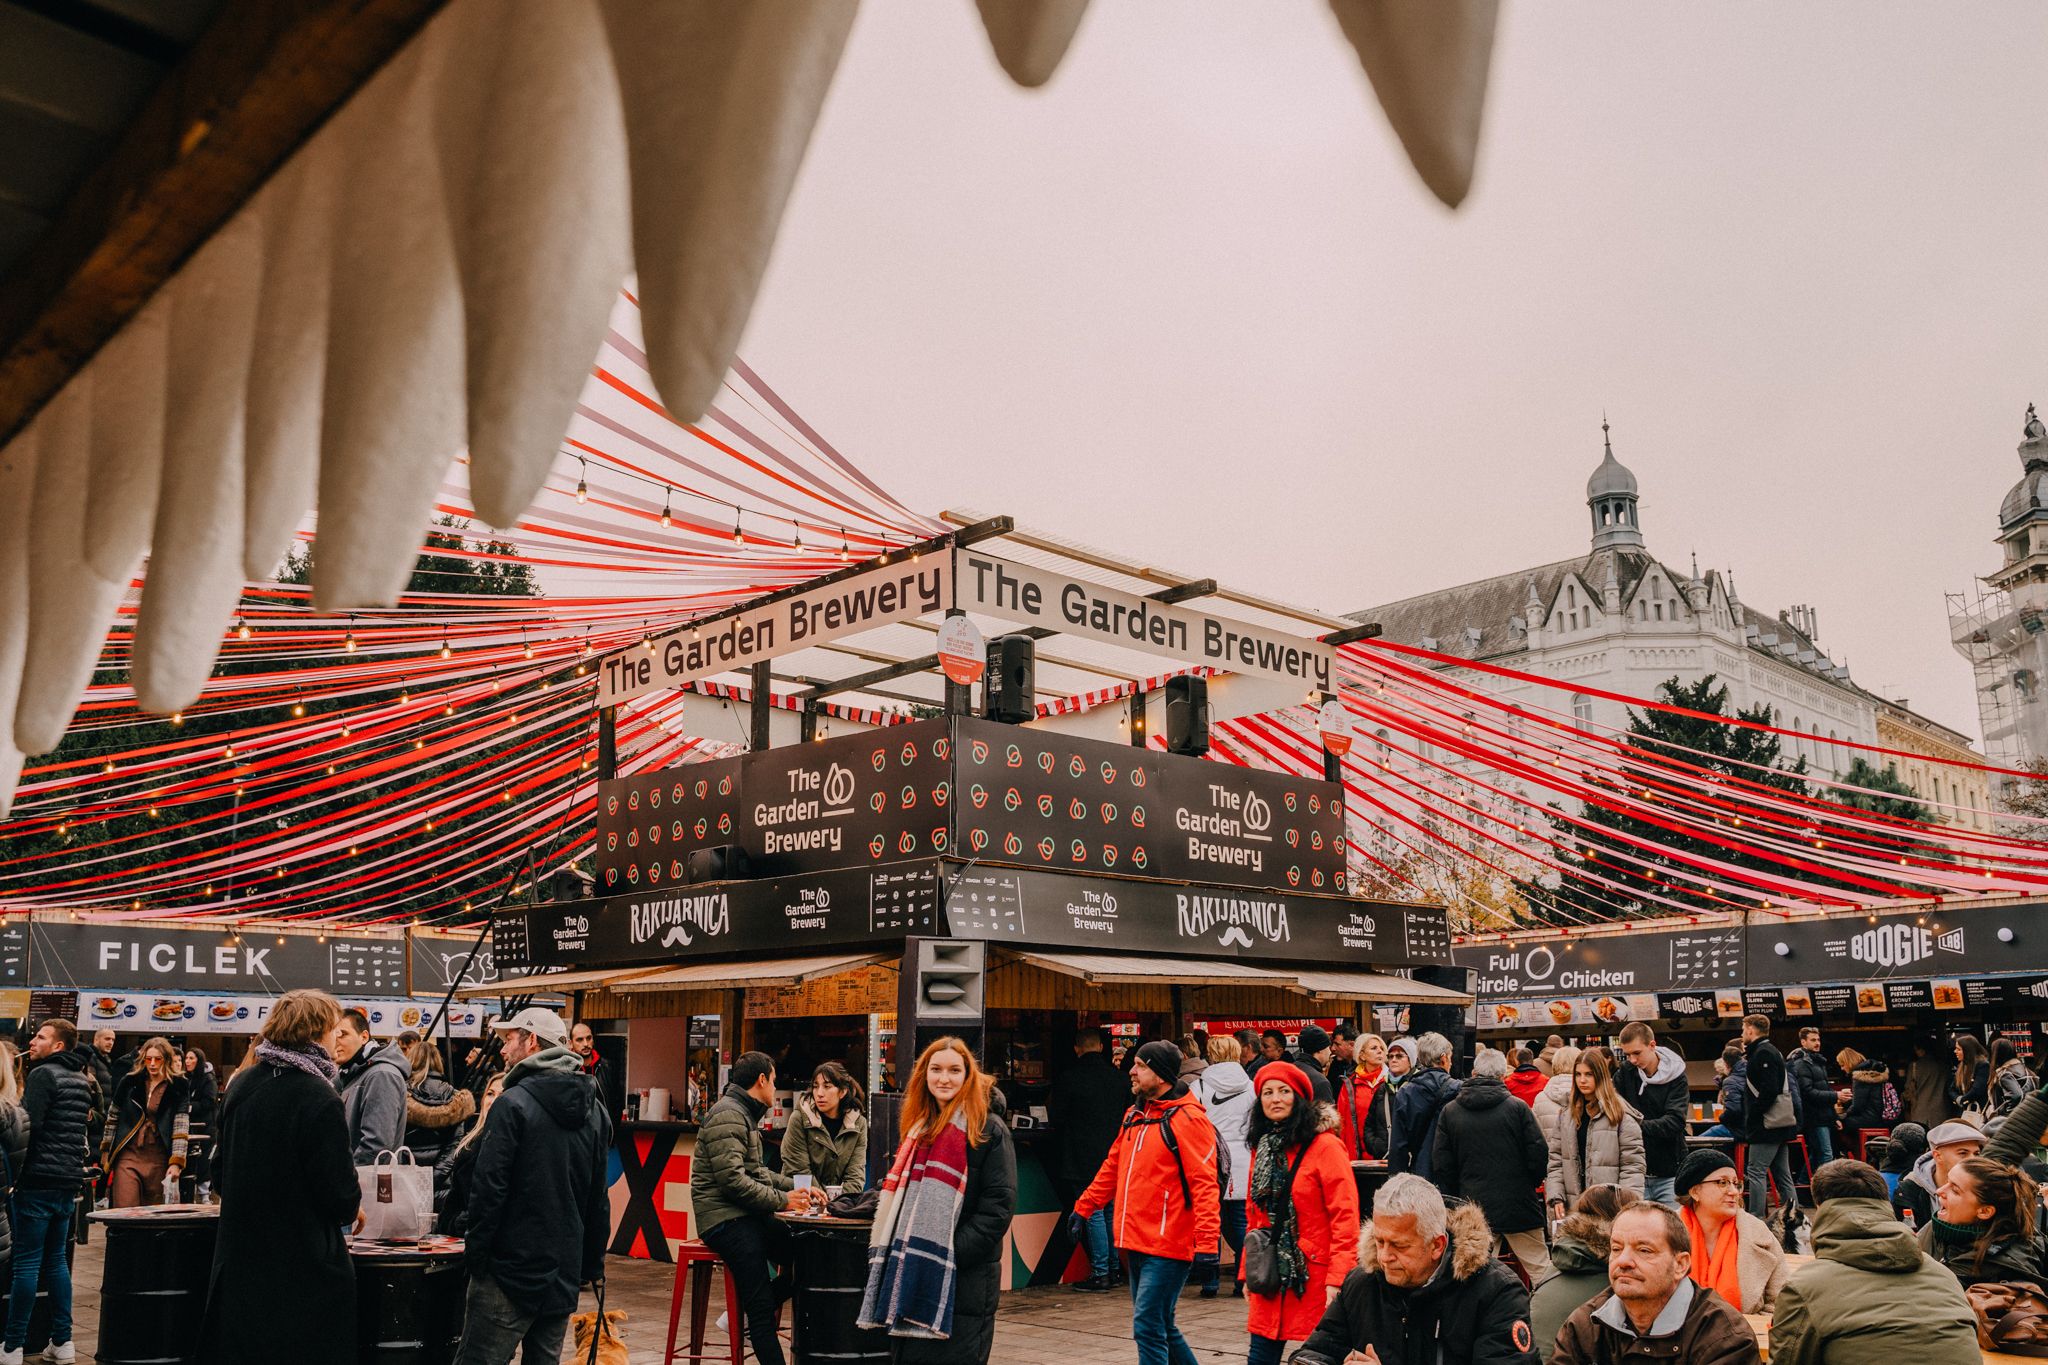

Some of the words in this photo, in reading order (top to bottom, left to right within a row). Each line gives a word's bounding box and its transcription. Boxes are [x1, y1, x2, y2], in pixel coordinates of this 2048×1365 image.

[606, 658, 650, 695] The
[664, 618, 774, 677] Garden
[790, 568, 941, 642] Brewery
[968, 557, 1042, 615] The
[1060, 583, 1188, 651] Garden
[1203, 618, 1330, 691] Brewery
[788, 768, 821, 793] The
[1208, 784, 1241, 810] The
[754, 798, 819, 826] Garden
[1175, 806, 1241, 837] Garden
[765, 827, 841, 854] Brewery
[1188, 837, 1263, 872] Brewery
[799, 888, 815, 902] The
[1083, 890, 1101, 903] The
[785, 901, 815, 917] Garden
[1066, 903, 1101, 917] Garden
[1176, 893, 1290, 943] RAKIJARNICA
[564, 916, 577, 926] The
[630, 893, 730, 945] RAKIJARNICA
[791, 915, 826, 930] Brewery
[1074, 917, 1114, 934] Brewery
[1350, 913, 1363, 925] The
[553, 928, 577, 939] Garden
[1338, 924, 1363, 936] Garden
[558, 940, 585, 950] Brewery
[1343, 936, 1372, 950] Brewery
[1851, 923, 1933, 967] BOOGIE
[1941, 932, 1961, 950] LAB
[100, 941, 271, 977] FICLEK
[1489, 953, 1519, 971] Full
[1560, 969, 1635, 989] Chicken
[1672, 996, 1702, 1014] BOOGIE
